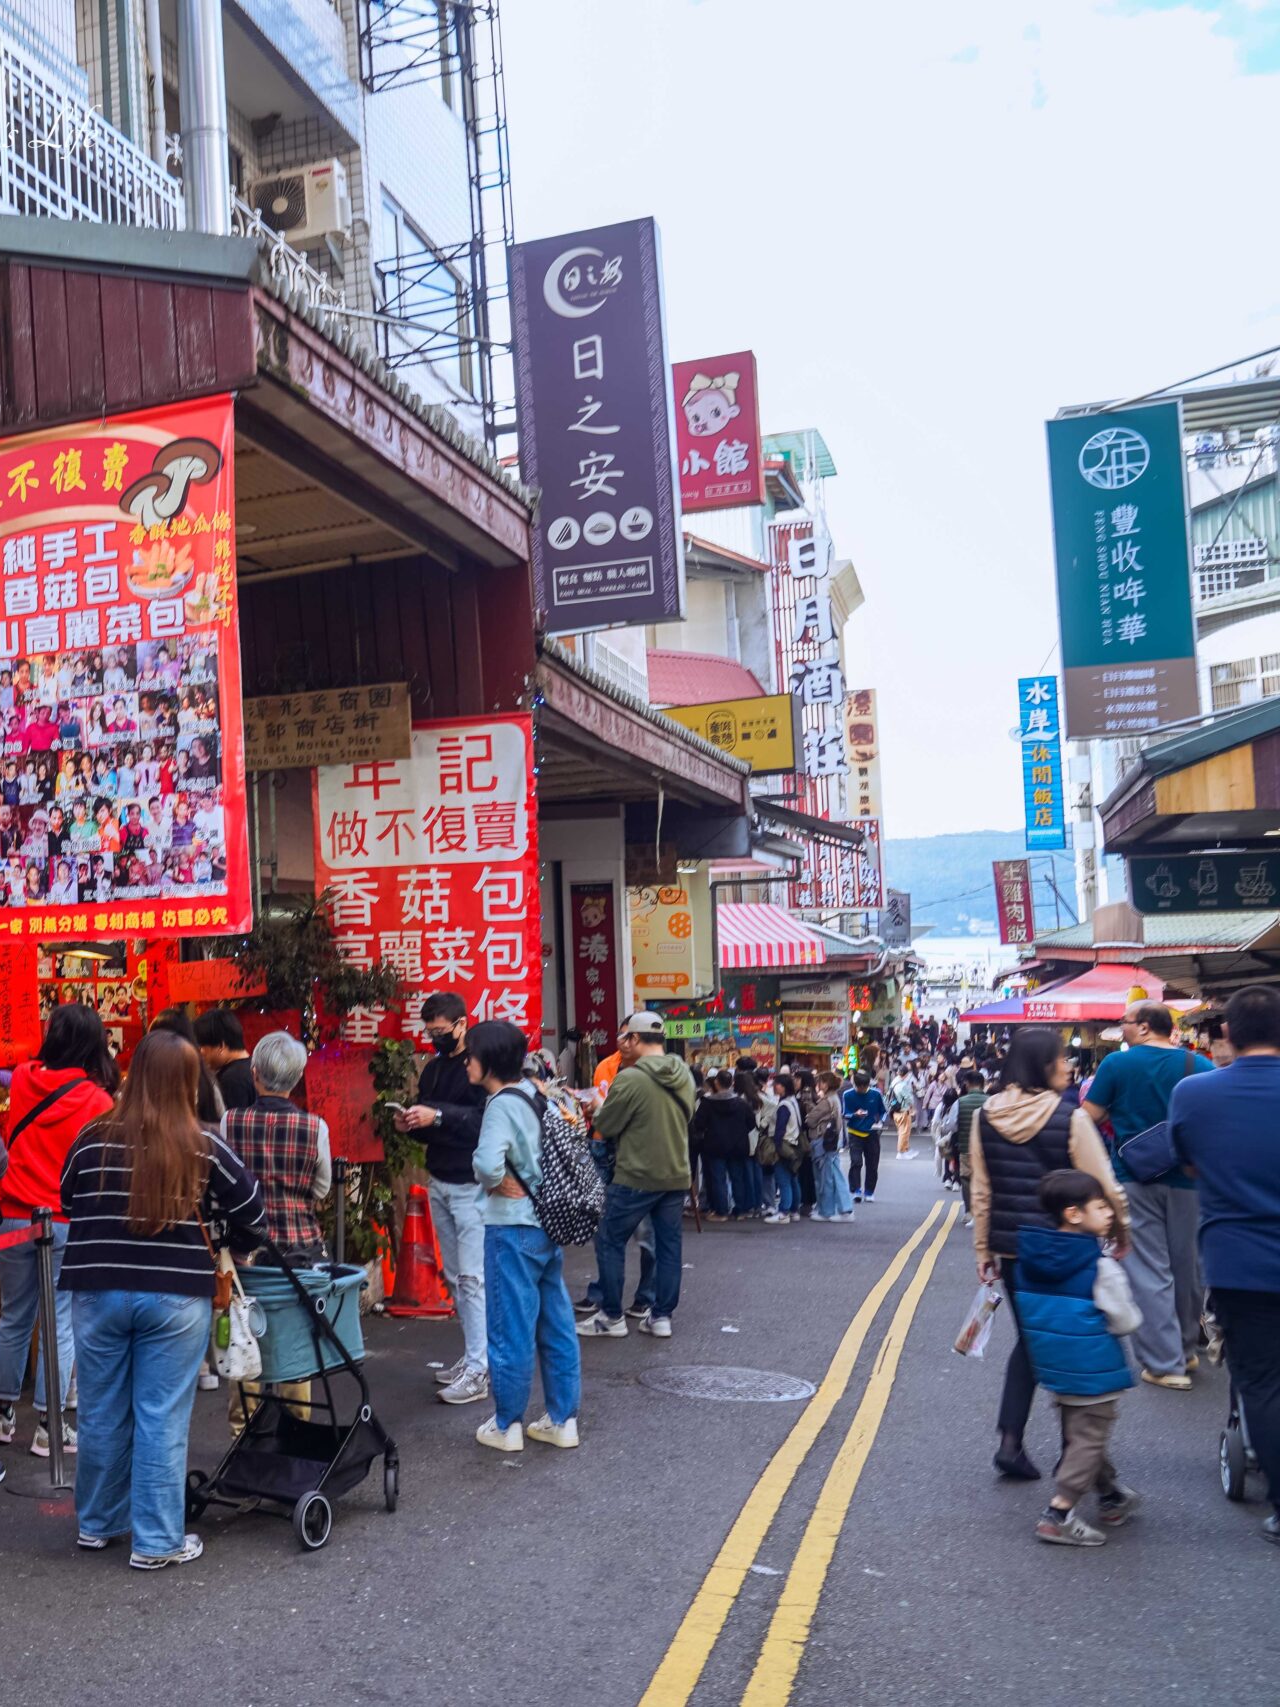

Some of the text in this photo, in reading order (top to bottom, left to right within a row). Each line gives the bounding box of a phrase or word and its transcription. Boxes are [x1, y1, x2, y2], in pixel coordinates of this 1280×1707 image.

[567, 333, 624, 501] 日之安
[682, 438, 749, 476] 小館
[3, 522, 119, 576] 純手工
[4, 566, 120, 617] 香菇包
[788, 536, 850, 778] 日月酒莊
[1025, 681, 1052, 731] 水岸
[344, 734, 498, 800] 年記
[326, 801, 518, 860] 做不復賣
[329, 866, 528, 927] 香菇包
[334, 926, 529, 983] 高麗菜包
